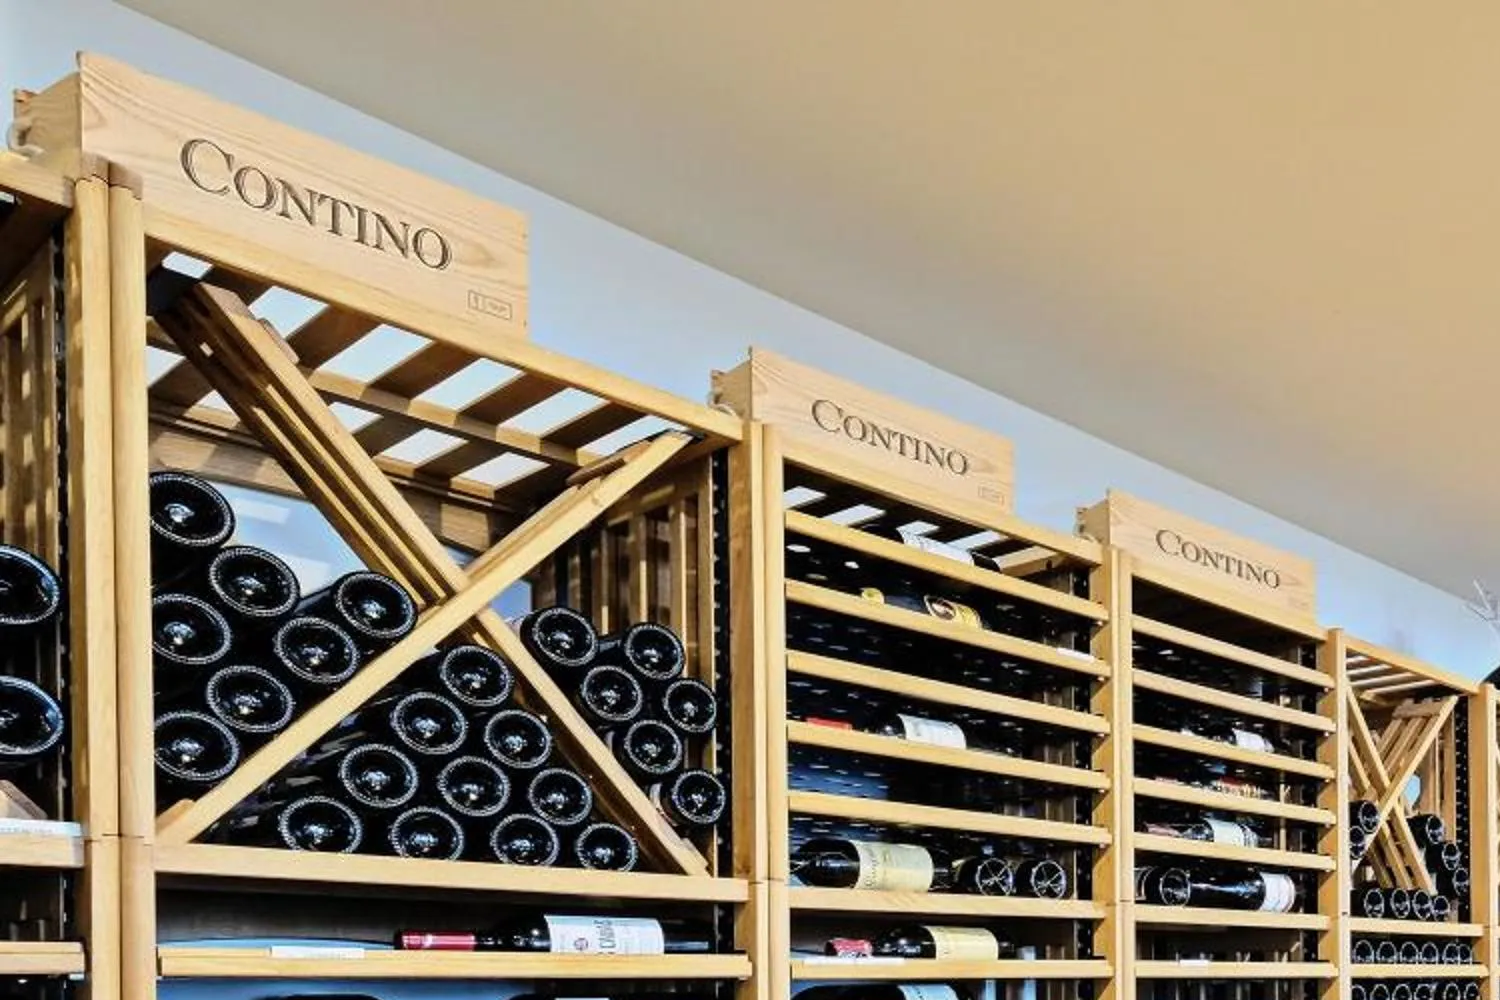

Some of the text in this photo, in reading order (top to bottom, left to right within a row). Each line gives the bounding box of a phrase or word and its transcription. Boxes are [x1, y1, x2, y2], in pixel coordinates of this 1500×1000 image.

[180, 138, 453, 270] CONTINO
[811, 399, 968, 476] CONTINO
[1155, 529, 1281, 589] CONTINO
